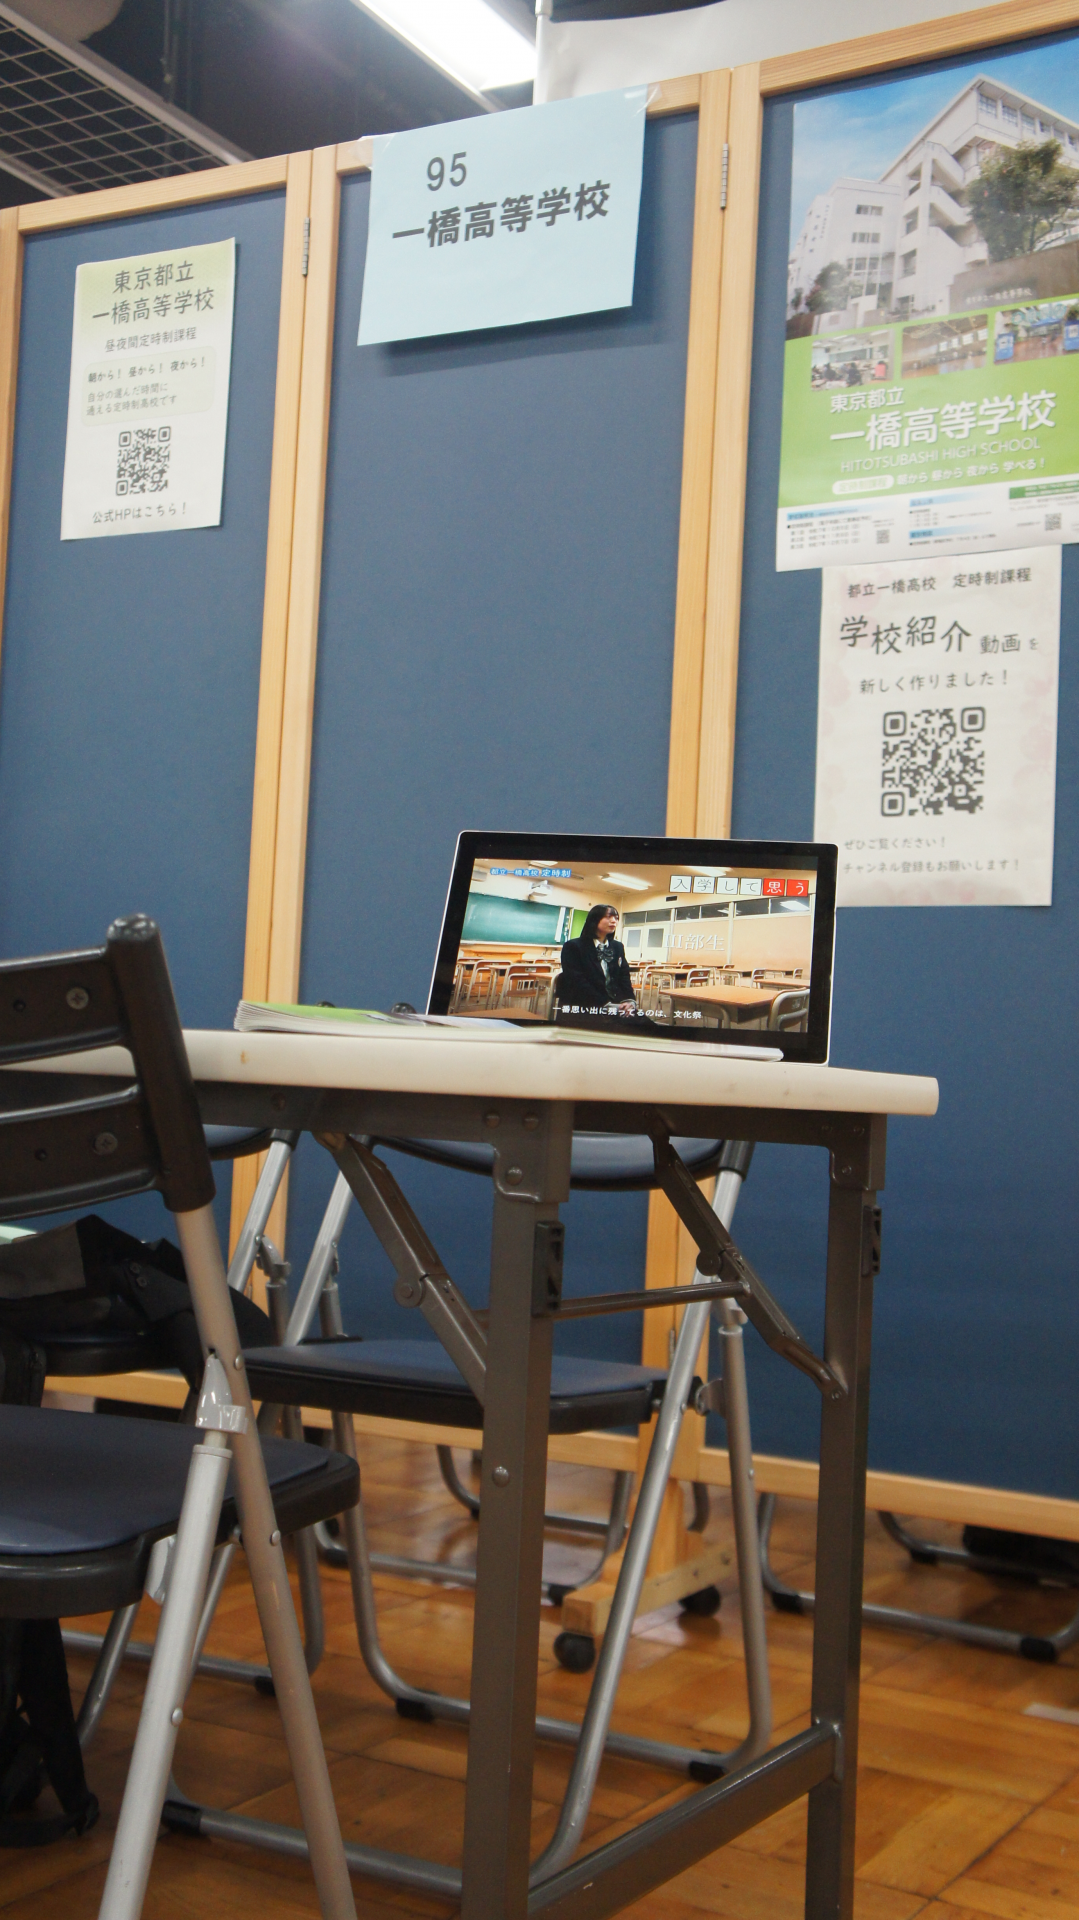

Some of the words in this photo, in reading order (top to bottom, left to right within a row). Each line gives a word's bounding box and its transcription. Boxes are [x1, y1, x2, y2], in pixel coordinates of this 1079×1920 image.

[427, 152, 467, 191] 95
[392, 180, 610, 247] 一橋高等学校
[112, 260, 194, 294] 東京都立
[92, 287, 214, 325] 一橋高等学校
[105, 327, 197, 352] 昼夜間定時制課程
[830, 387, 904, 414] 東京都立
[830, 389, 1057, 451] 一橋高等学校
[840, 451, 939, 473] HITOTSUBASHI
[942, 443, 977, 460] HIGH
[980, 437, 1041, 456] SCHOOL
[848, 576, 937, 598] 都立一橋高校
[953, 567, 1032, 589] 定時制課程
[840, 615, 972, 655] 学校紹介
[980, 634, 1021, 654] 動画
